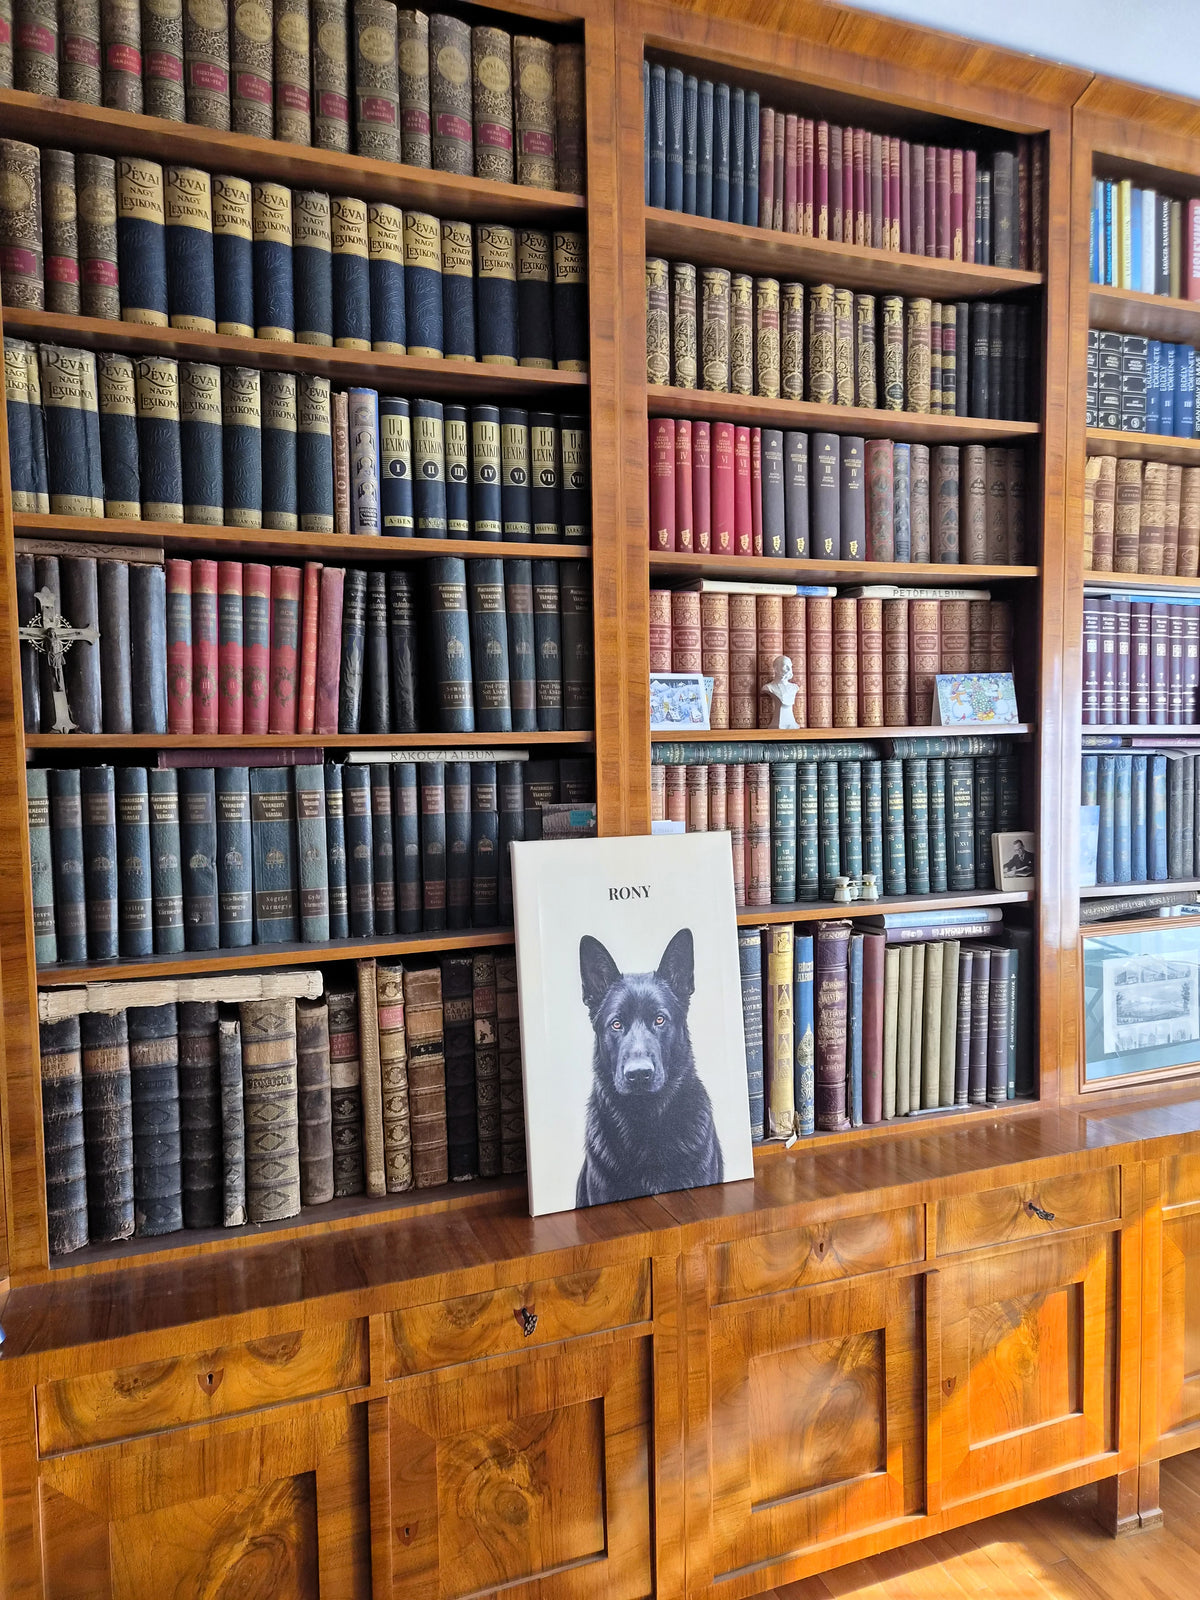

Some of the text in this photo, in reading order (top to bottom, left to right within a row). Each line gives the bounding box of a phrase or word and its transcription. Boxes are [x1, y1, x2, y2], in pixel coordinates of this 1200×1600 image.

[120, 162, 160, 189] RÉVAI
[168, 171, 206, 196] RÉVAI
[130, 187, 154, 198] NAGY
[213, 180, 249, 205] RÉVAI
[253, 188, 288, 211] RÉVAI
[120, 193, 162, 213] LEXIKONA
[177, 195, 201, 205] NAGY
[295, 195, 328, 218] RÉVAI
[168, 201, 209, 220] LEXIKONA
[222, 204, 245, 214] NAGY
[262, 210, 284, 220] NAGY
[332, 202, 365, 225] RÉVAI
[214, 210, 251, 228] LEXIKONA
[253, 218, 291, 234] LEXIKONA
[303, 216, 324, 226] NAGY
[369, 208, 401, 232] RÉVAI
[295, 223, 330, 241] LEXIKONA
[340, 225, 361, 233] NAGY
[405, 215, 438, 239] RÉVAI
[332, 232, 367, 248] LEXIKONA
[378, 231, 398, 240] NAGY
[415, 238, 434, 247] NAGY
[442, 225, 472, 247] RÉVA
[480, 228, 512, 250] RÉVAI
[520, 232, 548, 252] RÉVA
[369, 237, 402, 253] LEXIKONA
[452, 247, 470, 256] NAGY
[555, 236, 583, 256] RÉVA
[406, 244, 439, 261] LEXIKONA
[490, 250, 508, 258] NAGY
[443, 253, 472, 268] LEXIKON
[481, 256, 514, 271] LEXIKONA
[520, 259, 548, 274] LEXIKON
[555, 263, 584, 277] LEXIKO
[4, 351, 33, 369] ÉVAI
[46, 350, 89, 376] RÉVAI
[5, 369, 28, 377] NAGY
[139, 362, 178, 387] RÉVAI
[181, 368, 217, 391] RÉVAI
[5, 380, 37, 392] IKONA
[59, 376, 84, 385] NAGY
[48, 382, 93, 399] LEXIKONA
[150, 388, 173, 396] NAGY
[190, 391, 212, 399] NAGY
[302, 381, 328, 403] RÉVAI
[100, 393, 135, 407] EXIKONA
[141, 393, 179, 410] LEXIKONA
[231, 395, 253, 403] NAGY
[182, 400, 220, 414] LEXIKONA
[224, 405, 260, 418] EXIKONA
[304, 403, 325, 411] NAGY
[263, 409, 296, 421] XIKONA
[301, 410, 329, 425] LEXIKONA
[382, 438, 411, 452] LEXIKON
[415, 440, 442, 454] LEXIKON
[446, 442, 467, 456] EXIKO
[474, 444, 499, 457] LEXIKO
[503, 446, 527, 460] LEXIKO
[534, 448, 555, 462] LEXIK
[564, 451, 582, 464] LEXIK
[396, 464, 401, 472] I
[428, 465, 435, 474] II
[454, 468, 464, 476] III
[484, 469, 494, 478] IV
[513, 472, 523, 480] VI
[541, 474, 554, 482] VII
[608, 884, 651, 901] RONY
